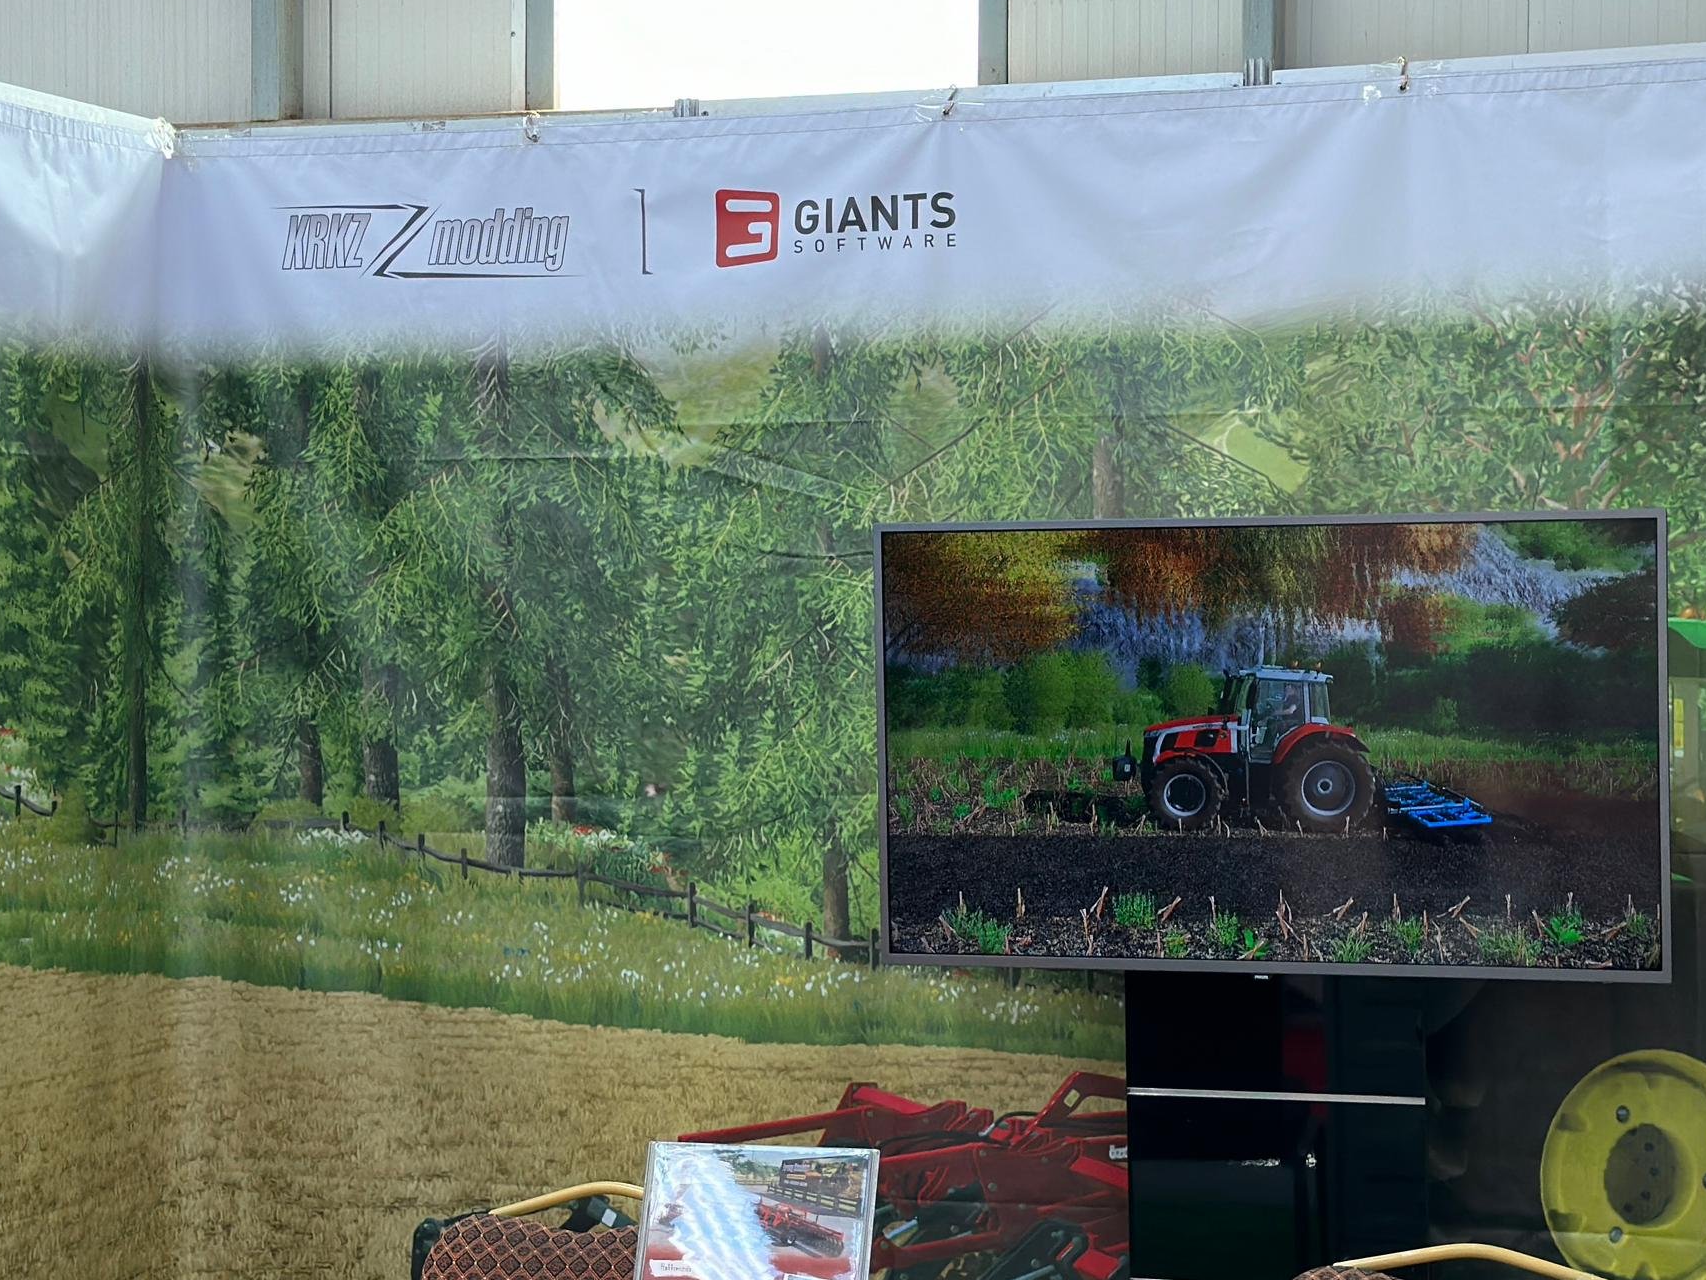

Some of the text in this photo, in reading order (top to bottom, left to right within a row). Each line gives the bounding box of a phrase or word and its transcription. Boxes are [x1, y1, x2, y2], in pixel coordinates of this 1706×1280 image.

[794, 191, 957, 234] GIANTS
[281, 207, 570, 272] KRKZ modding
[794, 233, 957, 255] SOFTWARE
